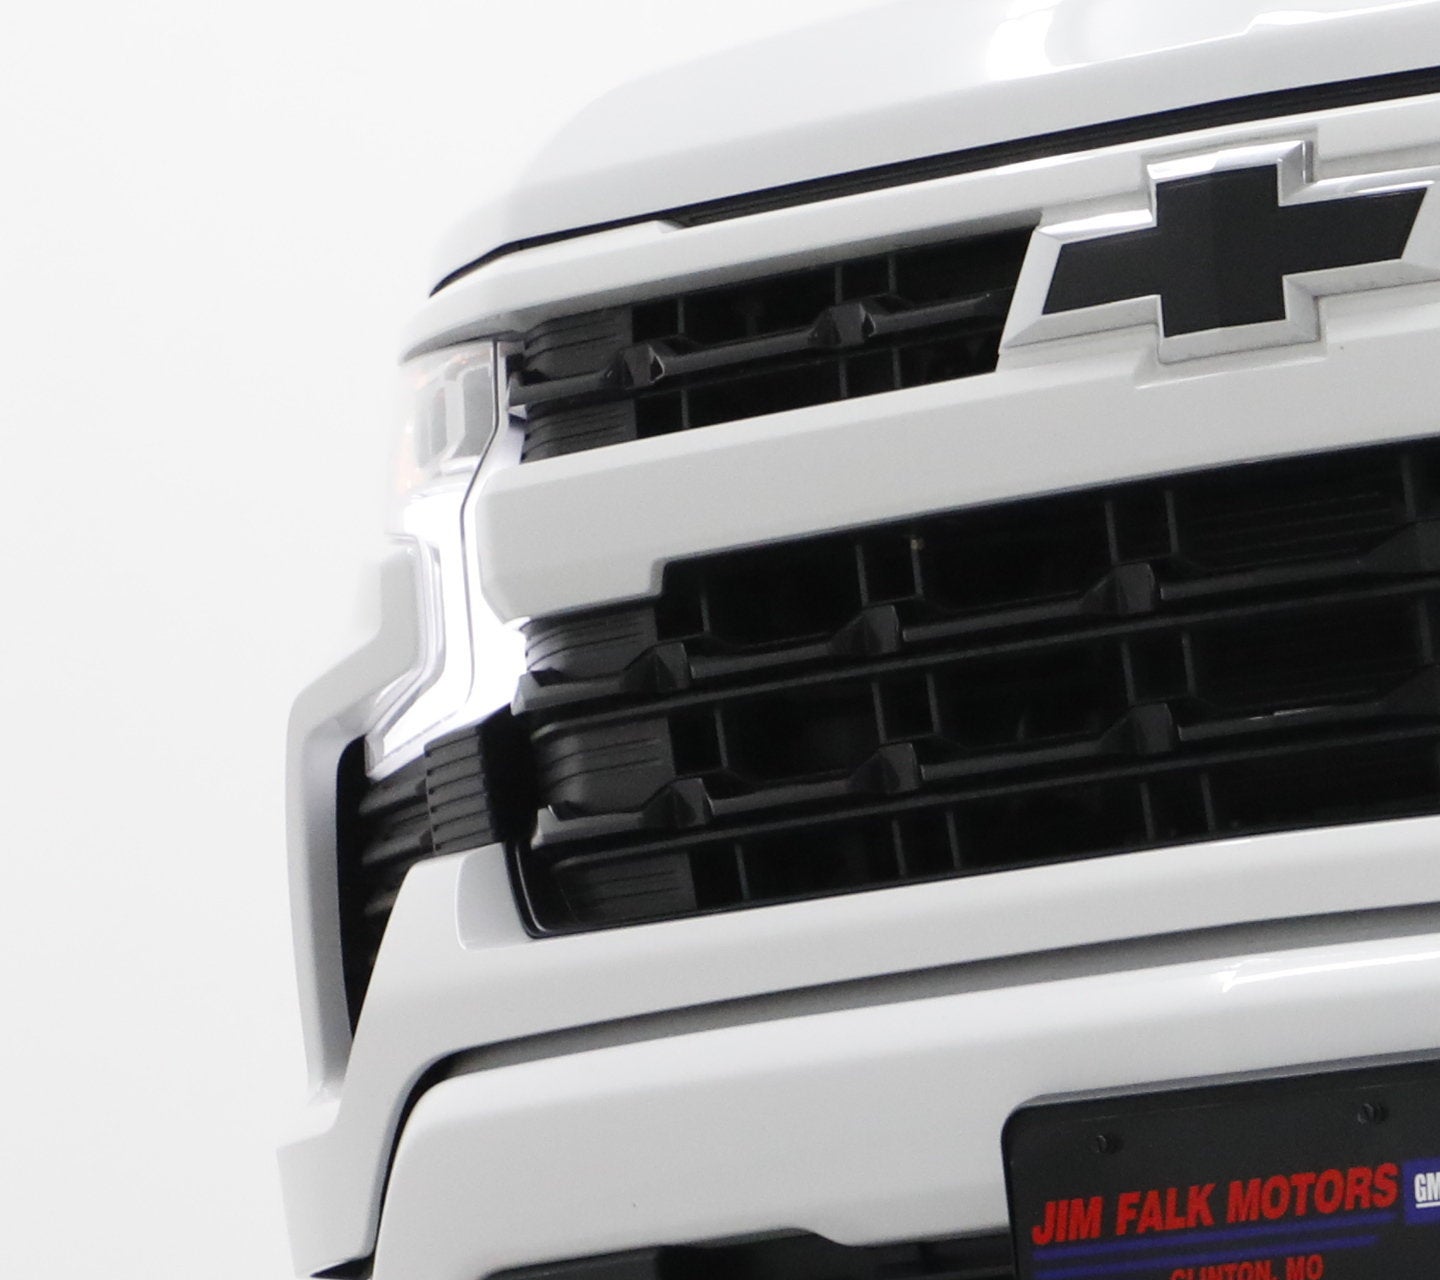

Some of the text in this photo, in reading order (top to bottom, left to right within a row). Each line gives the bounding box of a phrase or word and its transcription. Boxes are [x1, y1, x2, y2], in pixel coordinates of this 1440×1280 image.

[1032, 1163, 1400, 1245] JIM FALK MOTORS
